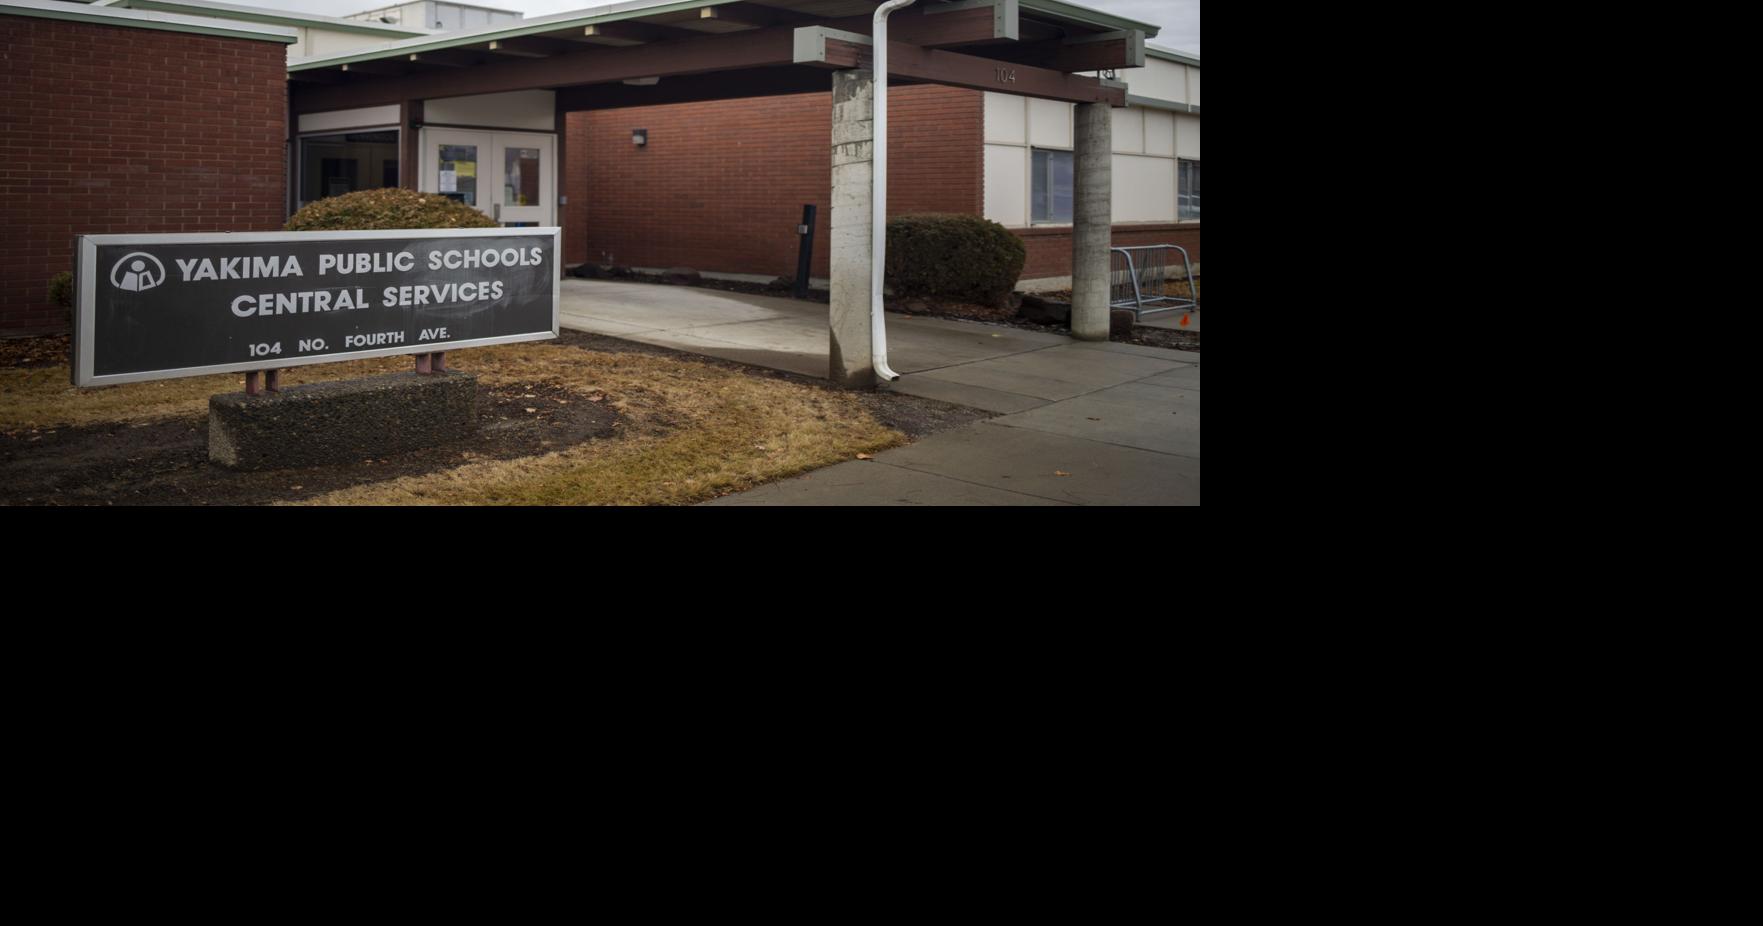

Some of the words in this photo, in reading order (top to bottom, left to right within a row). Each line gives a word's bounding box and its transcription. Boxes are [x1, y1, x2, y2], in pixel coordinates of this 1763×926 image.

[995, 67, 1016, 83] 104
[175, 255, 304, 282] YAKIMA
[318, 252, 415, 276] PUBLIC
[427, 246, 543, 271] SCHOOLS
[231, 289, 370, 317] CENTRAL
[382, 280, 505, 308] SERVICES
[248, 342, 283, 357] 104
[298, 338, 330, 352] NO.
[345, 331, 404, 348] FOURTH
[418, 327, 451, 342] AVE.
